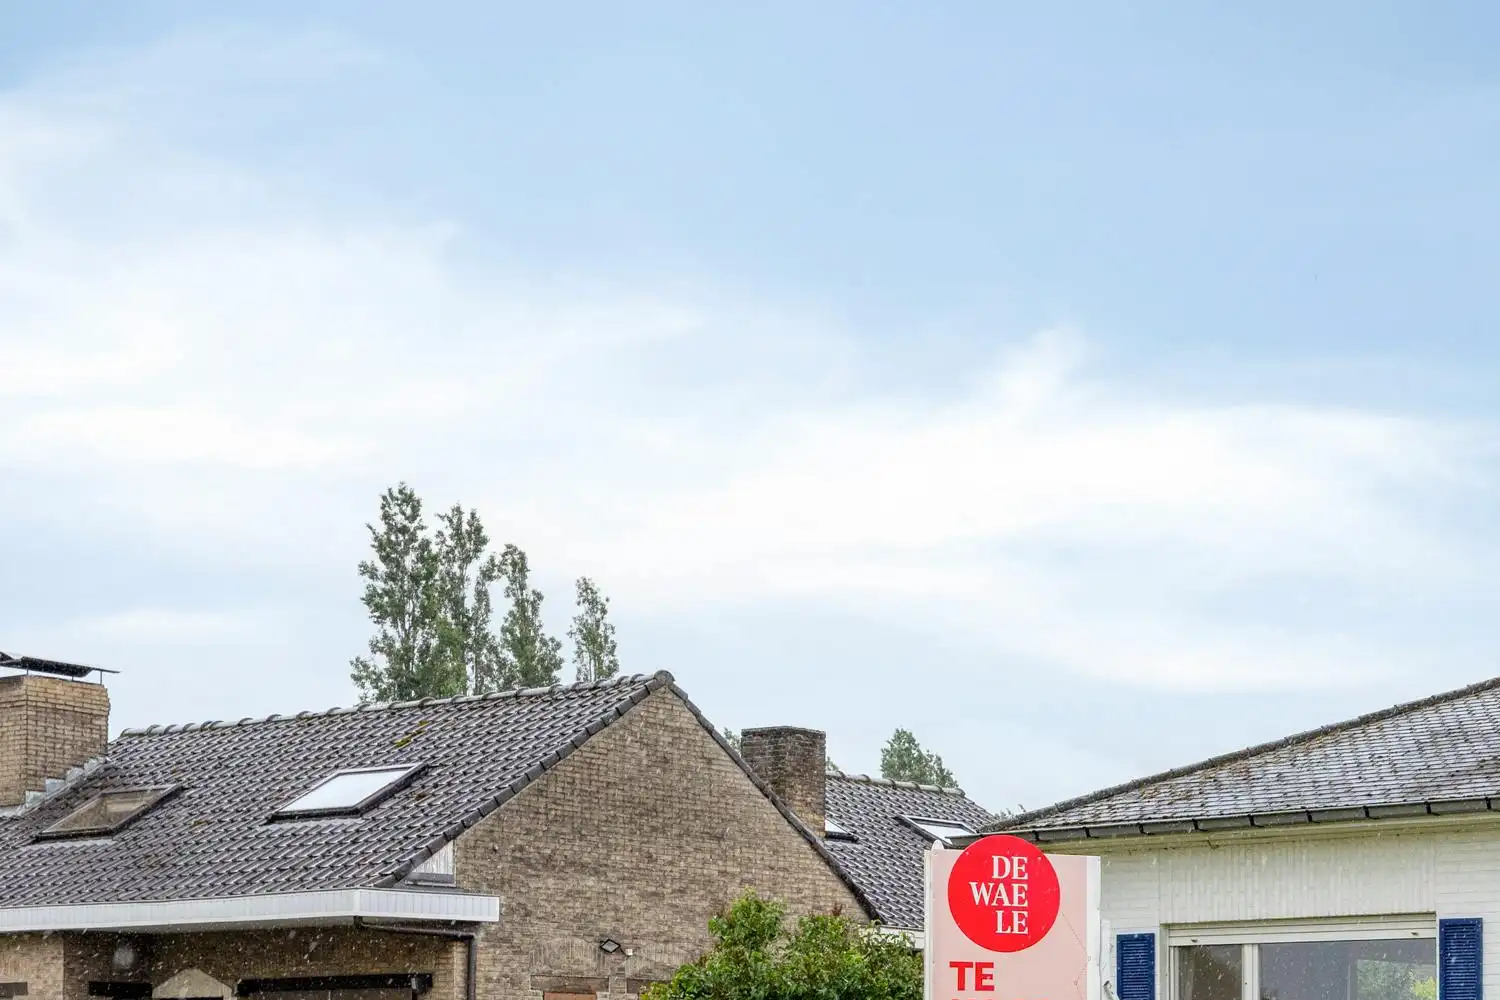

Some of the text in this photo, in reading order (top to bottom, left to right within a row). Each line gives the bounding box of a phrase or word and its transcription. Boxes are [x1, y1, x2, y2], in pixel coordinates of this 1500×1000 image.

[992, 855, 1028, 880] DE
[968, 881, 1028, 907] WAE
[995, 910, 1028, 934] LE
[949, 961, 995, 991] TE
